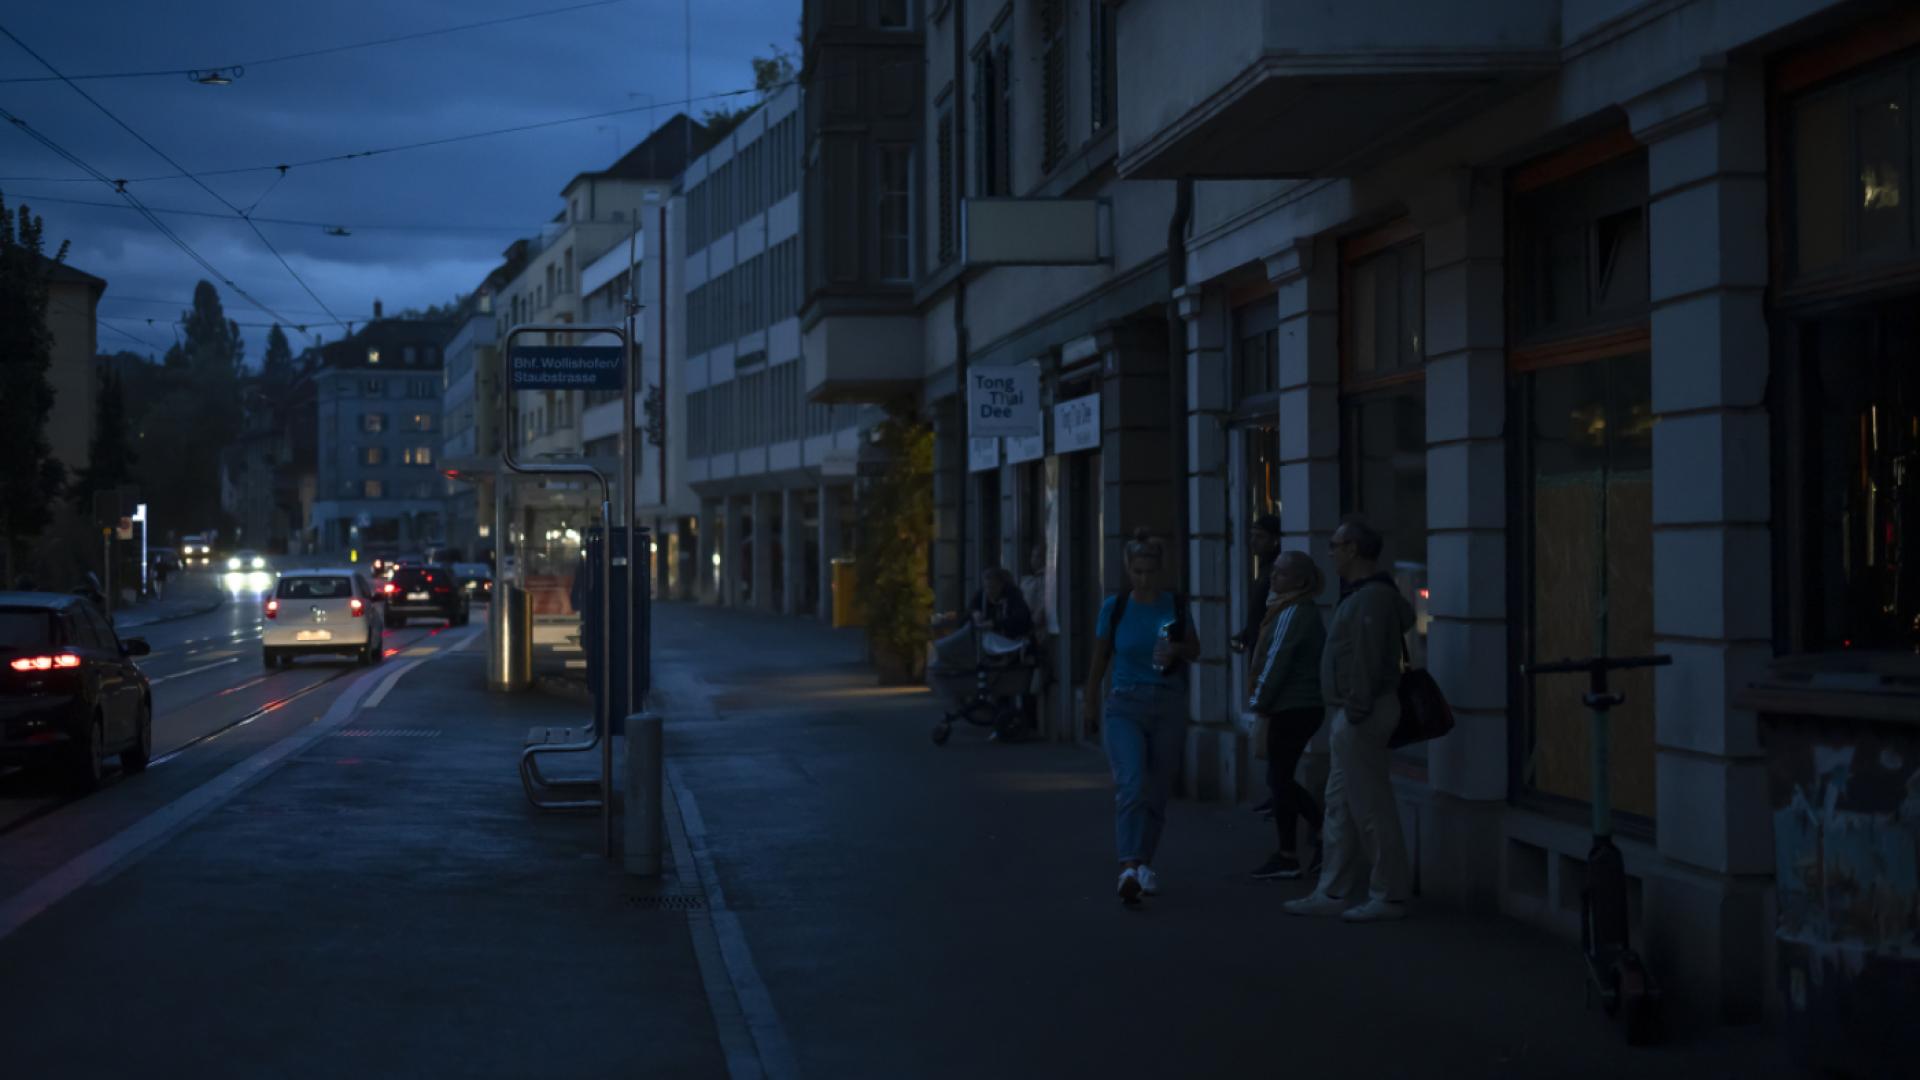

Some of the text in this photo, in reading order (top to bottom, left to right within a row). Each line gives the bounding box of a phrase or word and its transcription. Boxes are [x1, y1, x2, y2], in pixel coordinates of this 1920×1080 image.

[514, 357, 619, 369] Bhf. Wollishofen/
[514, 371, 597, 383] Staubstrasse
[975, 375, 1015, 392] Tong
[989, 390, 1023, 405] Thai
[981, 404, 1012, 418] Dee
